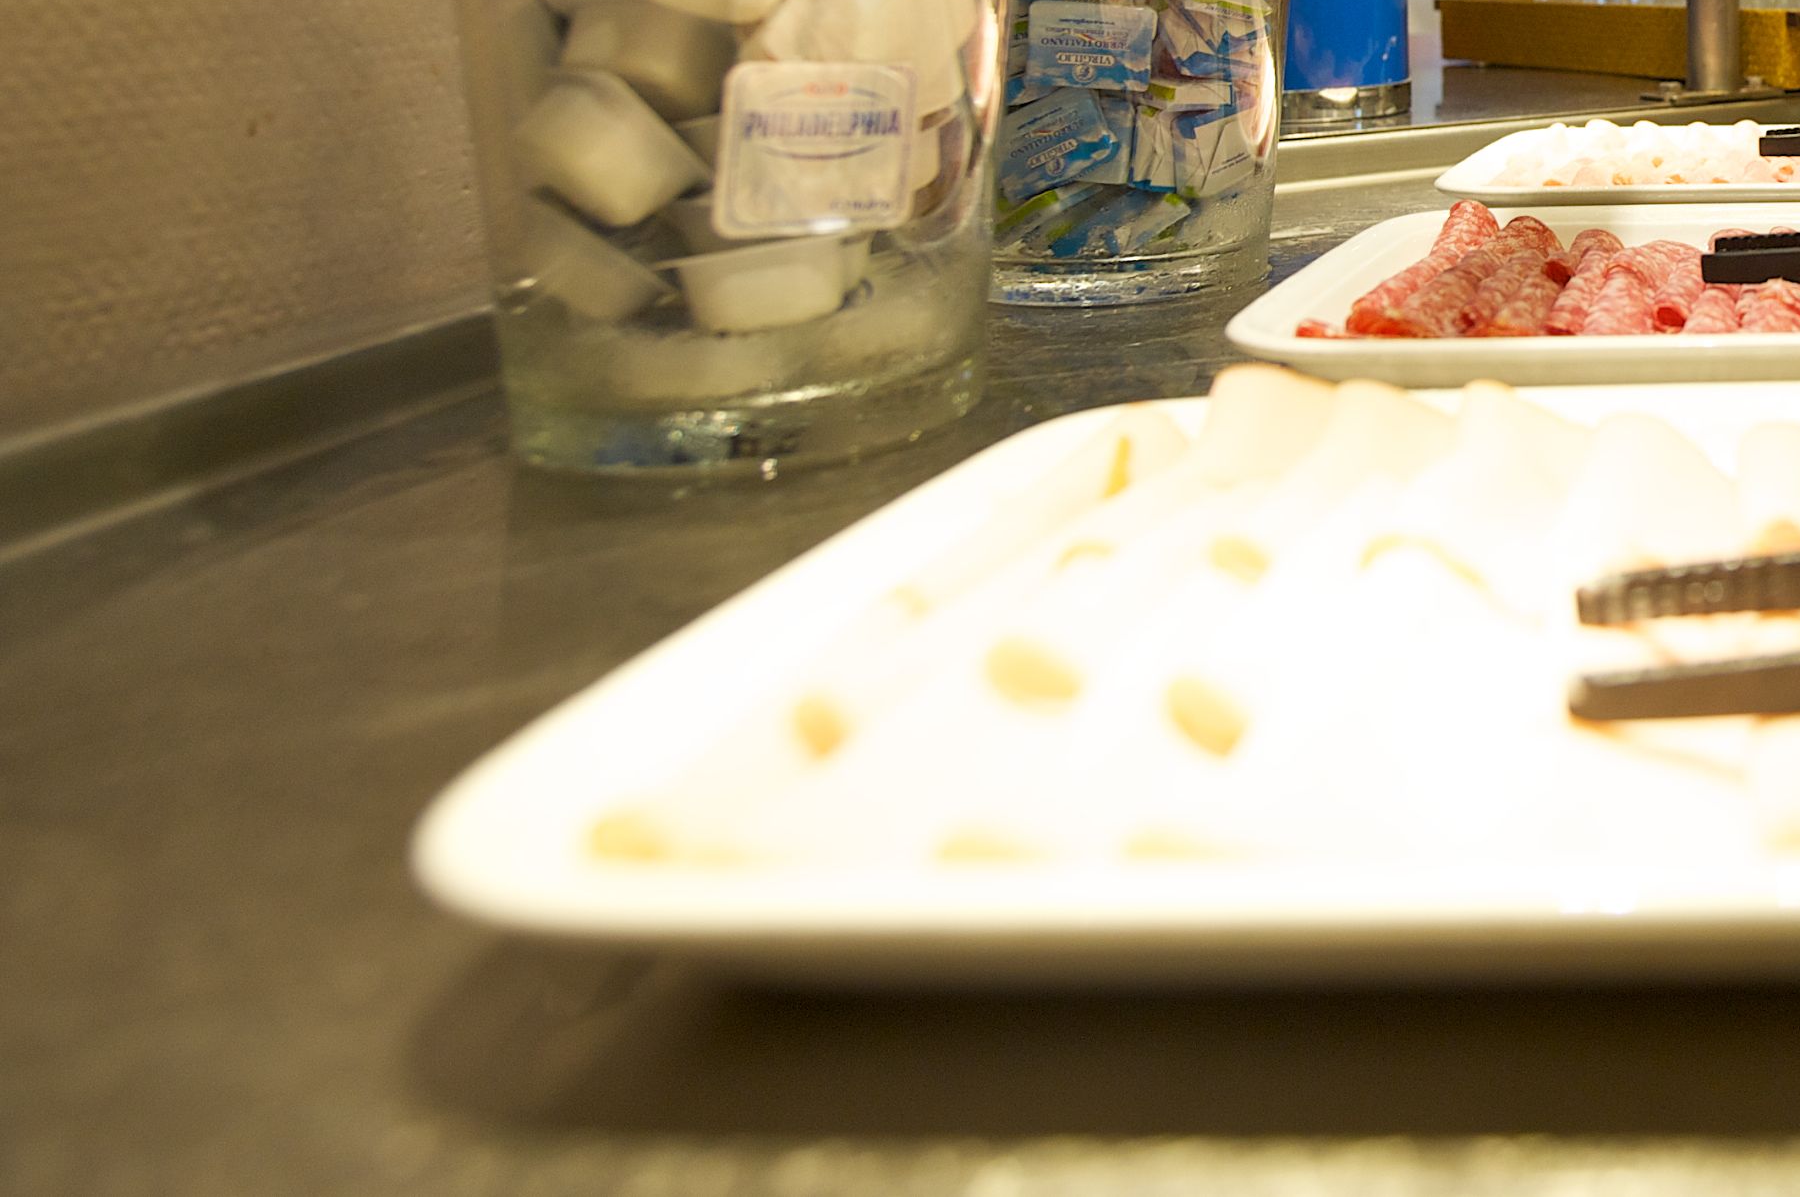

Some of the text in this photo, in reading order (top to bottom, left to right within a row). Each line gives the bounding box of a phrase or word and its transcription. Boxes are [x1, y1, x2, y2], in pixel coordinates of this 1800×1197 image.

[1041, 37, 1095, 49] ITALIANO
[1058, 53, 1113, 65] VIRGILIO
[743, 108, 900, 141] PHILADELPHIA
